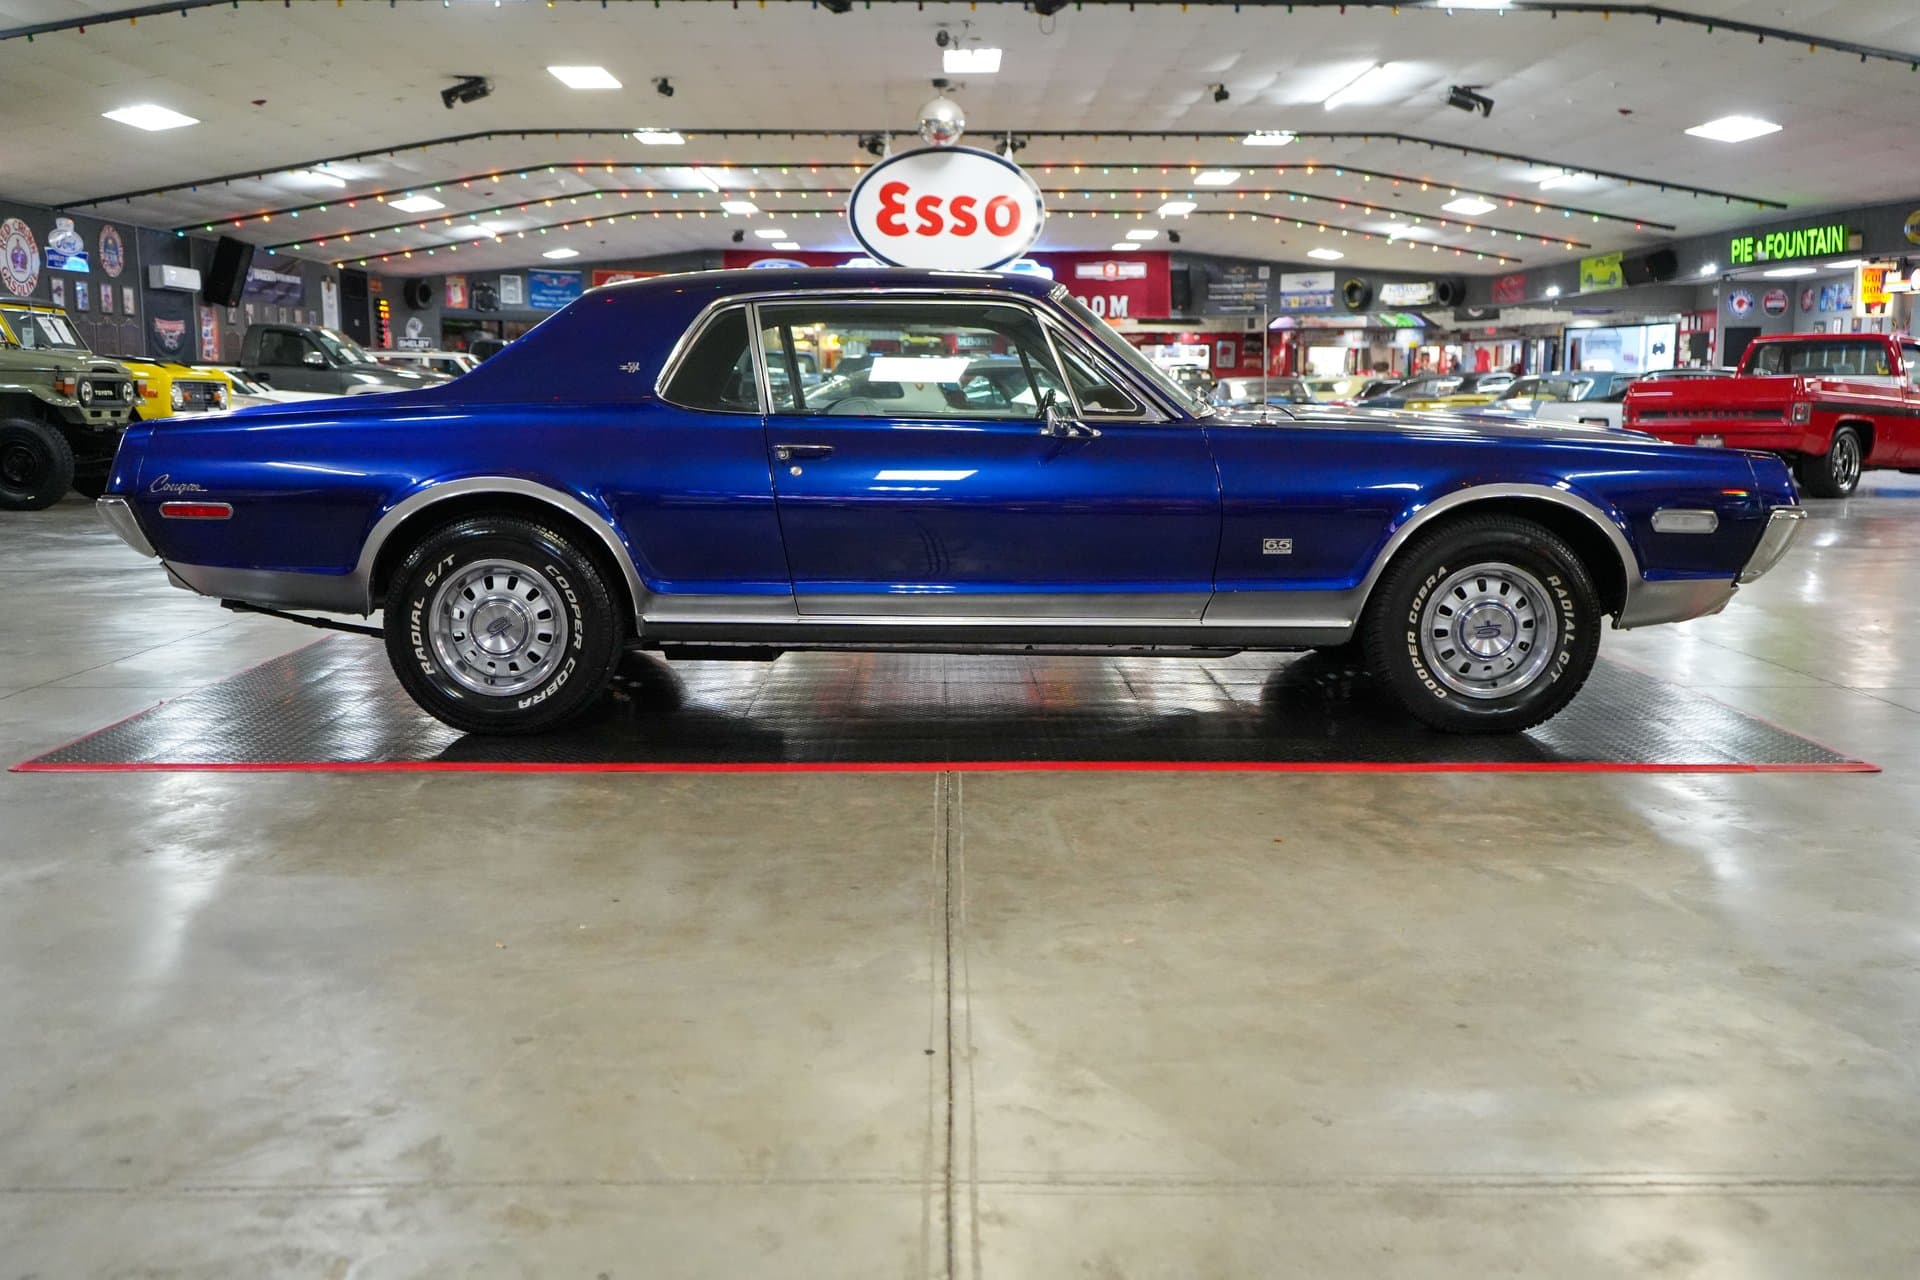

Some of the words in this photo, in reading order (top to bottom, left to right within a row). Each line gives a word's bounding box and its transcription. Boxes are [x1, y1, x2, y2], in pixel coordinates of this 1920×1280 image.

[876, 181, 1021, 236] Esso
[1731, 236, 1753, 264] PIE
[1765, 224, 1843, 259] FOUNTAIN
[399, 339, 430, 348] SHELBY
[149, 474, 208, 495] Cougar
[411, 597, 435, 675] RADIAL
[424, 553, 455, 588] G/T
[545, 564, 583, 650] COOPER
[1409, 566, 1448, 624] COBRA
[1546, 575, 1575, 645] RADIAL
[518, 657, 576, 709] COBRA
[1407, 630, 1448, 699] COOPER
[1550, 651, 1571, 683] G/T
